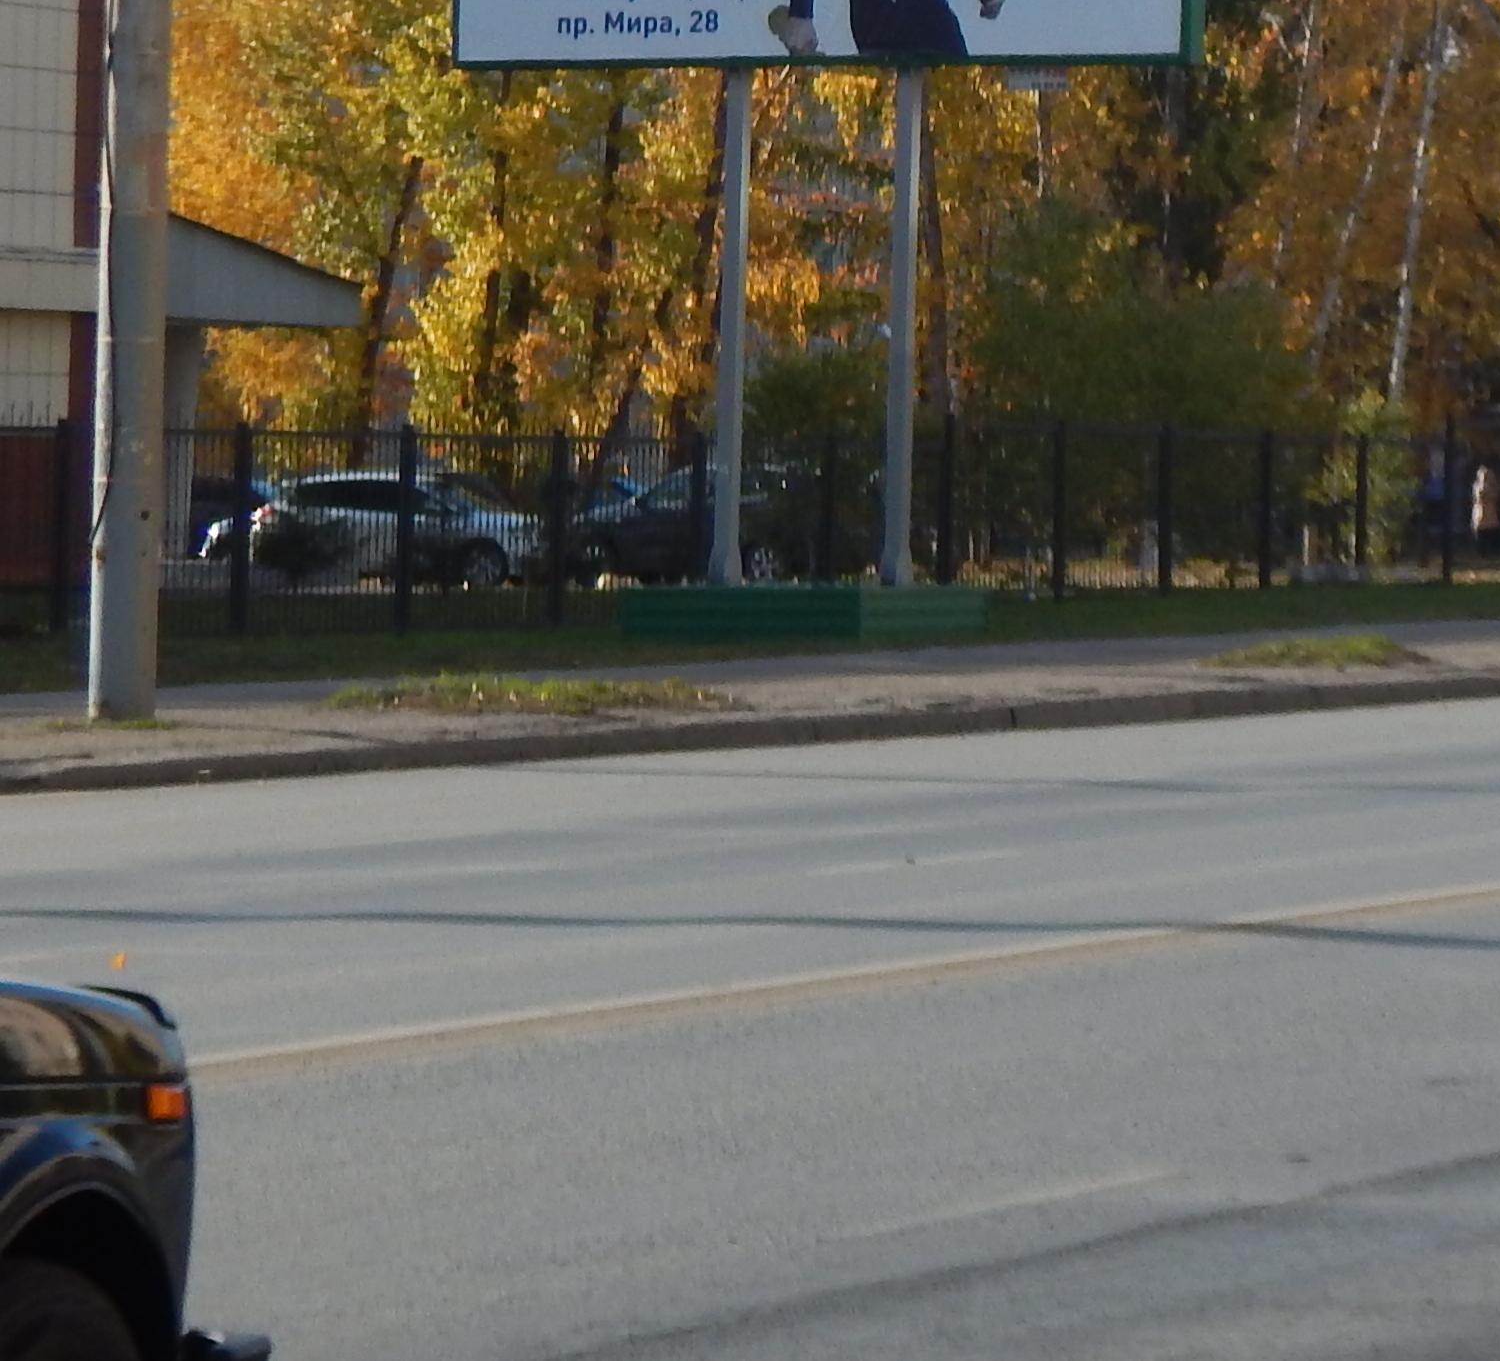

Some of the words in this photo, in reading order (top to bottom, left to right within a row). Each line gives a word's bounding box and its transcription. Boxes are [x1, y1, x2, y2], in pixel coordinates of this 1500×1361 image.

[557, 15, 595, 40] пр.
[604, 11, 681, 39] Мира,
[690, 9, 719, 34] 28
